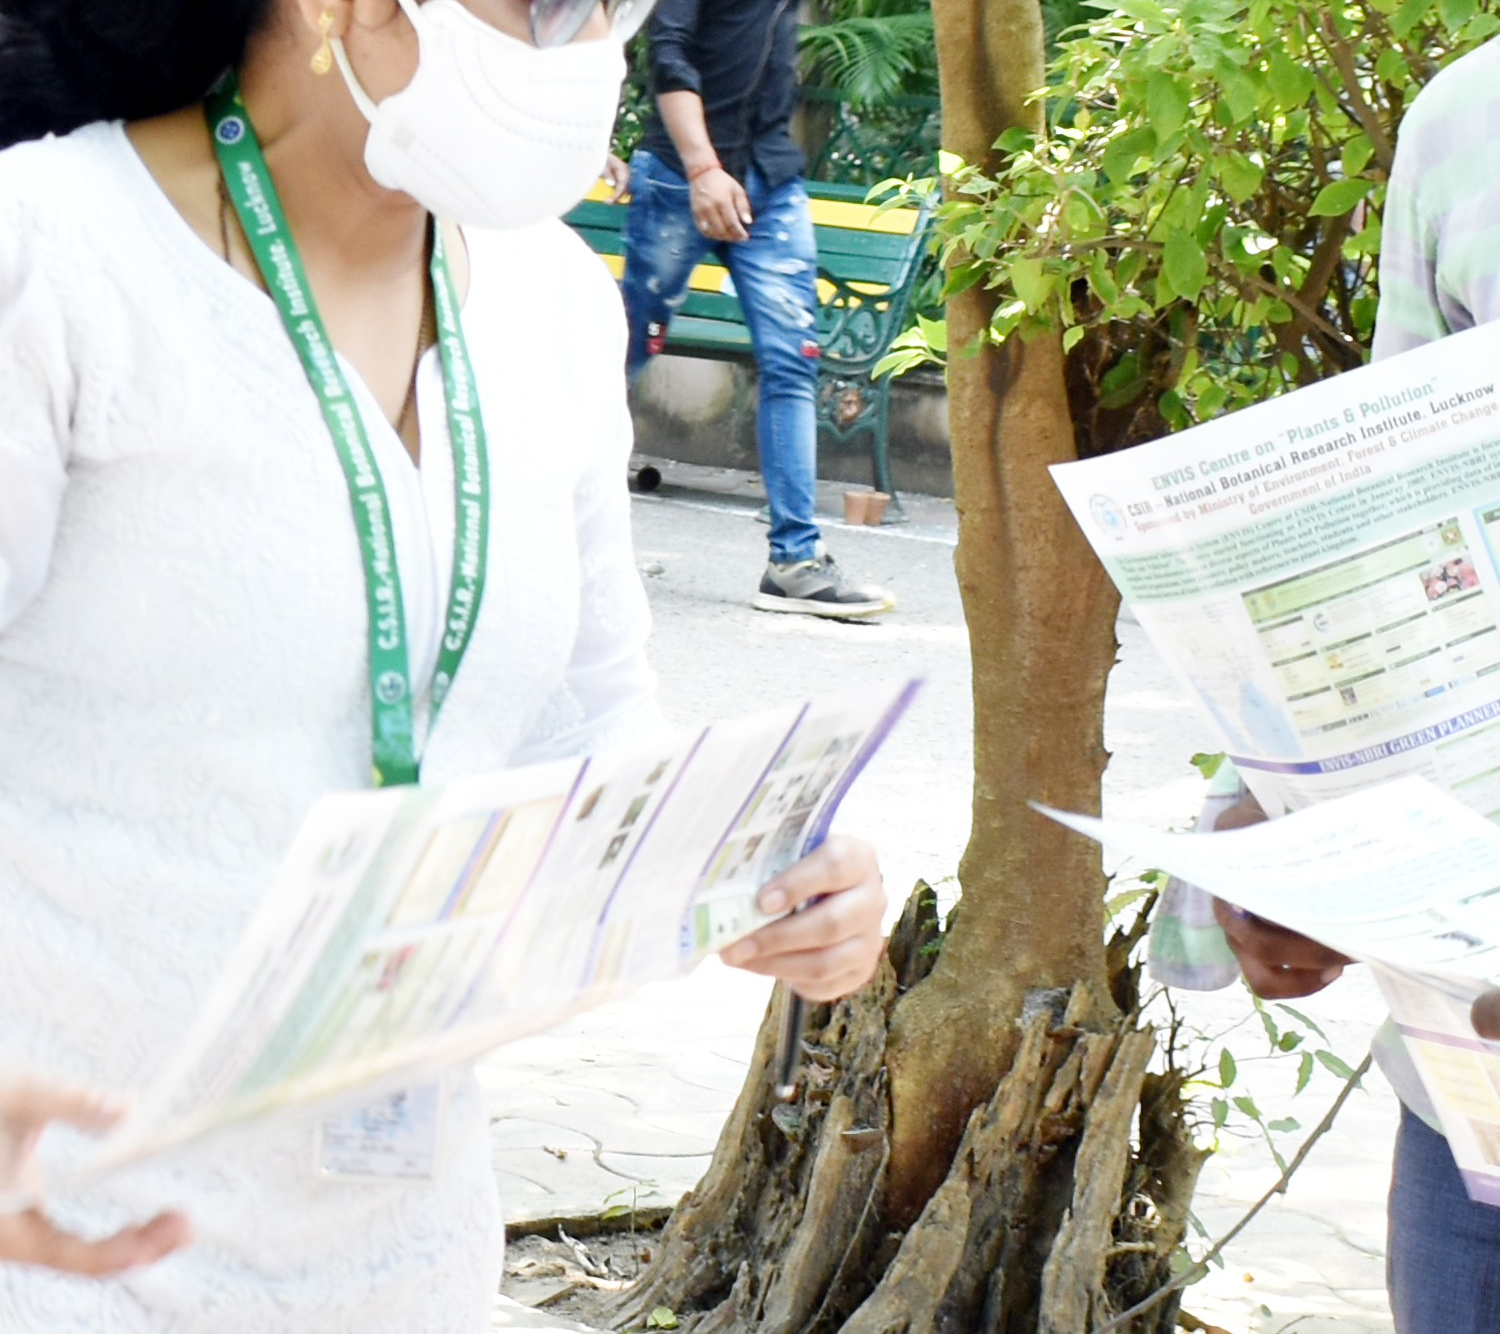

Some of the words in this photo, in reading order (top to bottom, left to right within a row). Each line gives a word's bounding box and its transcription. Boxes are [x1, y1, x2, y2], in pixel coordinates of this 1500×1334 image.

[237, 160, 278, 236] Lucknow
[329, 402, 377, 488] Botanical
[453, 413, 482, 496] Botanical
[1153, 467, 1194, 490] ENVIS
[1199, 449, 1249, 475] Centre
[1254, 440, 1274, 456] on
[1343, 408, 1355, 423] &
[1164, 481, 1215, 507] National
[1220, 458, 1285, 488] Botanical
[1290, 433, 1355, 463] Research
[1430, 383, 1494, 413] Lucknow
[1182, 505, 1196, 521] by
[1199, 491, 1244, 515] Ministry
[1247, 484, 1260, 497] of
[1347, 441, 1383, 461] Forest
[1387, 435, 1397, 447] &
[1400, 419, 1447, 442] Climate
[1249, 482, 1320, 514] Government
[1323, 474, 1336, 488] of
[1339, 463, 1370, 482] India
[1318, 744, 1390, 773] ENVIS-NBRI
[1389, 727, 1438, 756] GREEN
